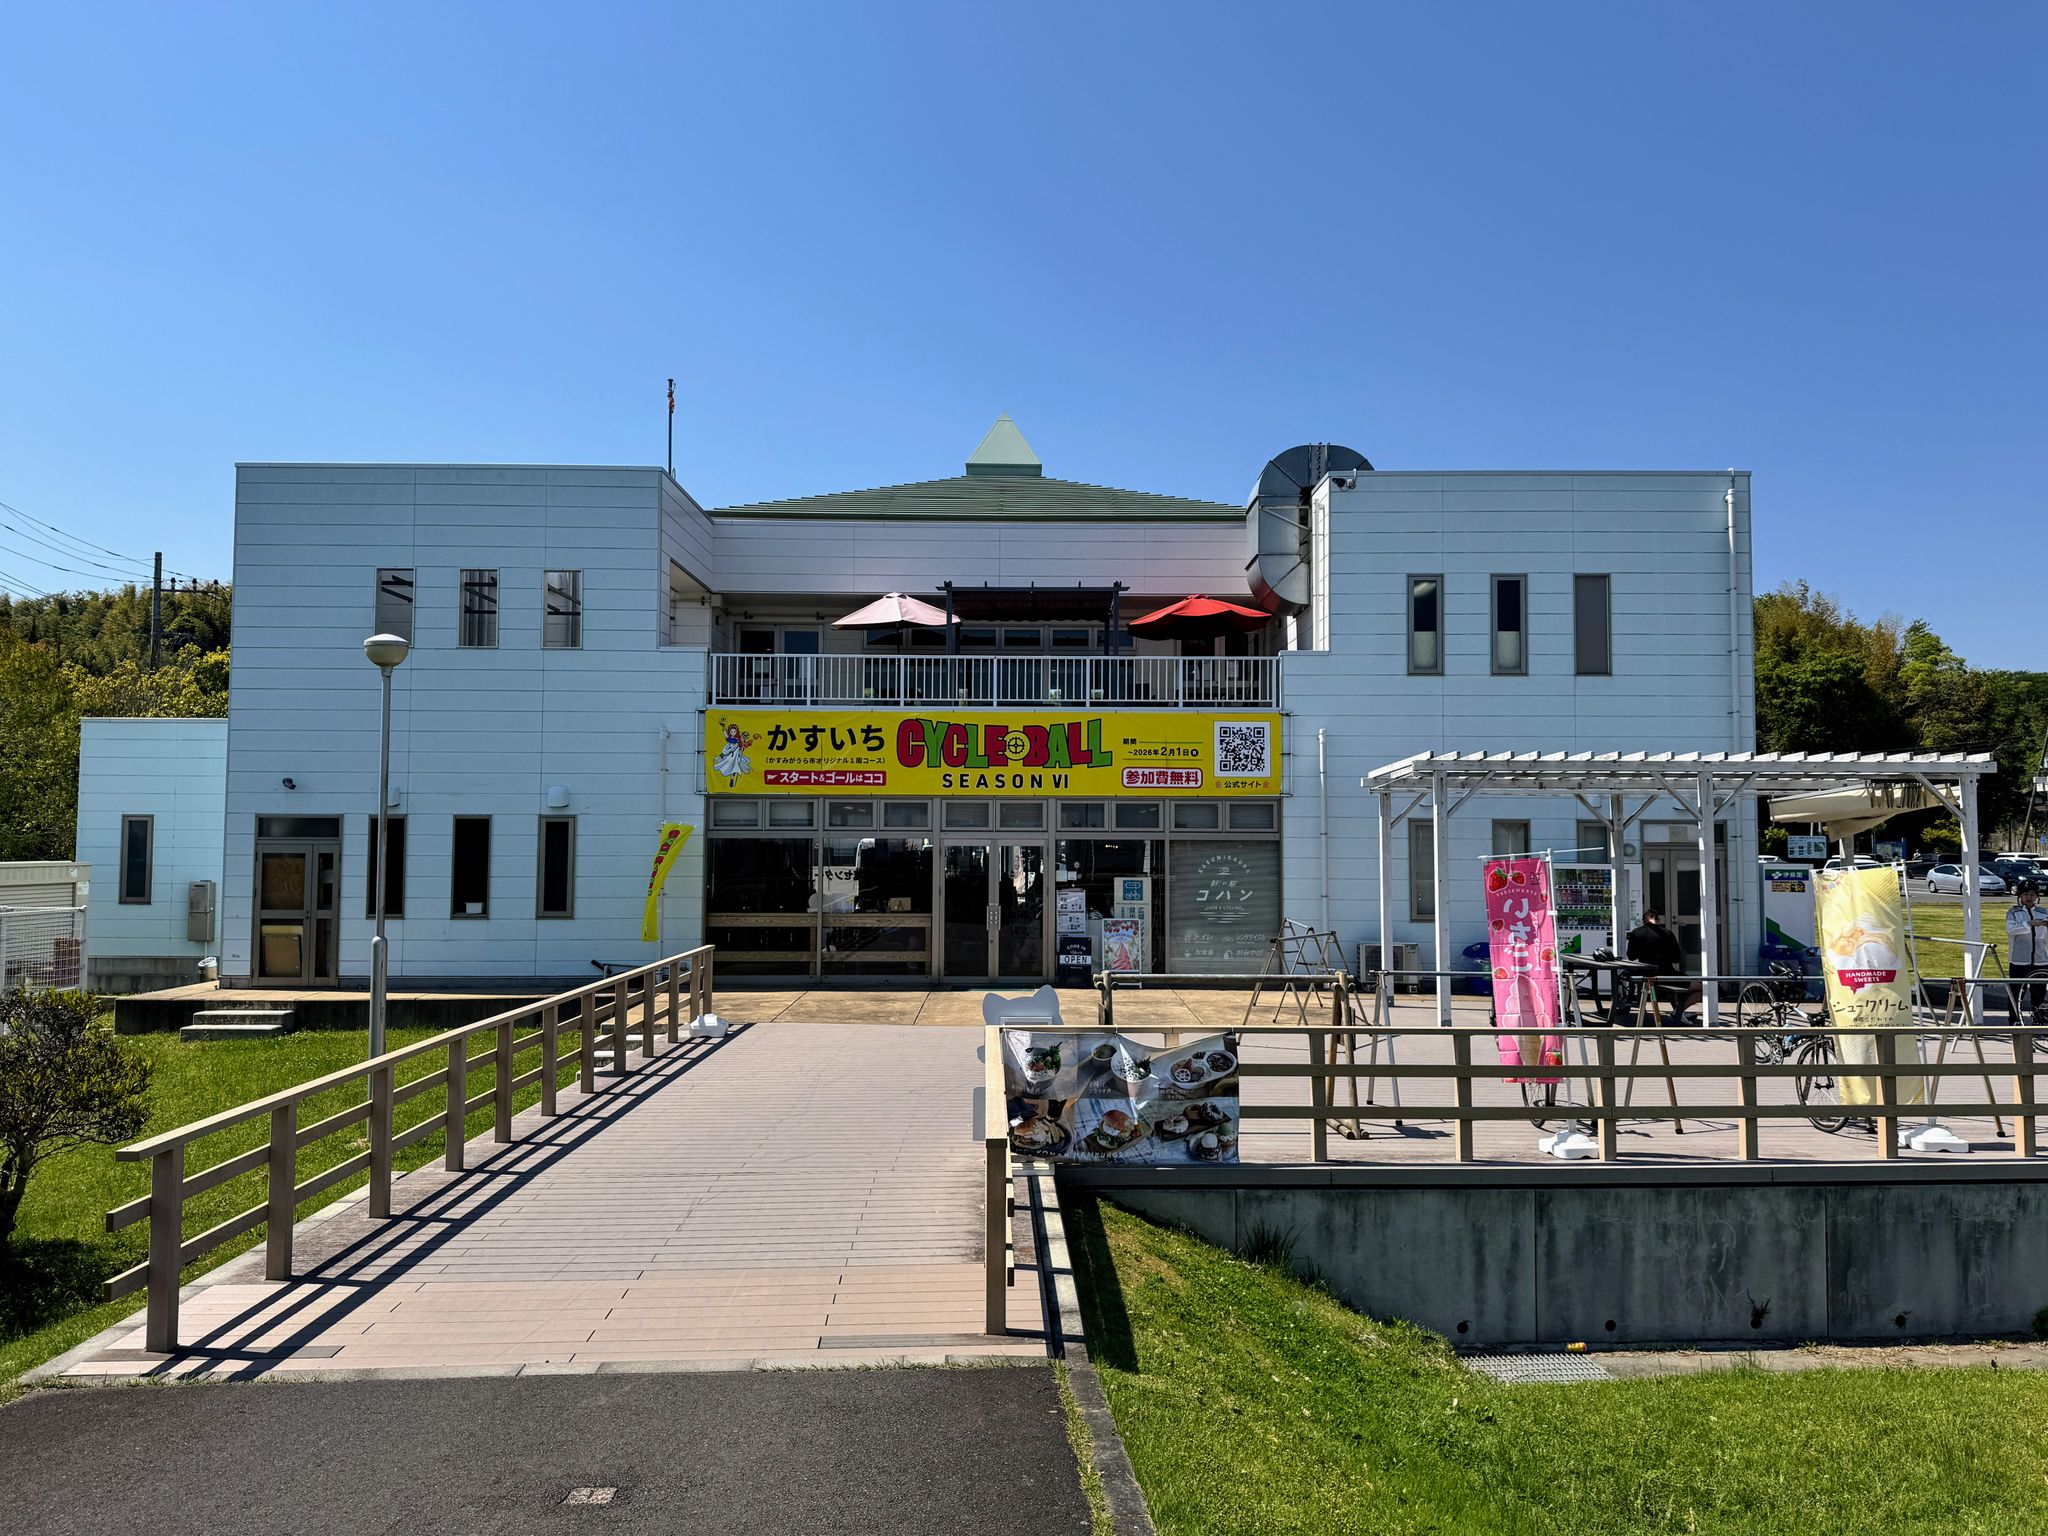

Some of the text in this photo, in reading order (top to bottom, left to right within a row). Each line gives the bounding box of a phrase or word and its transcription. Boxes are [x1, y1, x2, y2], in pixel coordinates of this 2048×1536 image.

[767, 724, 885, 752] かすいち
[896, 718, 1113, 768] CYCLE BALL
[780, 772, 883, 783] スタート&ゴールはココ
[942, 774, 1069, 789] SEASON VI
[1125, 771, 1199, 785] 参加費無料
[1223, 781, 1262, 789] 公式サイト
[1196, 889, 1253, 902] コハン
[1065, 955, 1088, 963] OPEN
[1832, 999, 1909, 1013] シュークリーム
